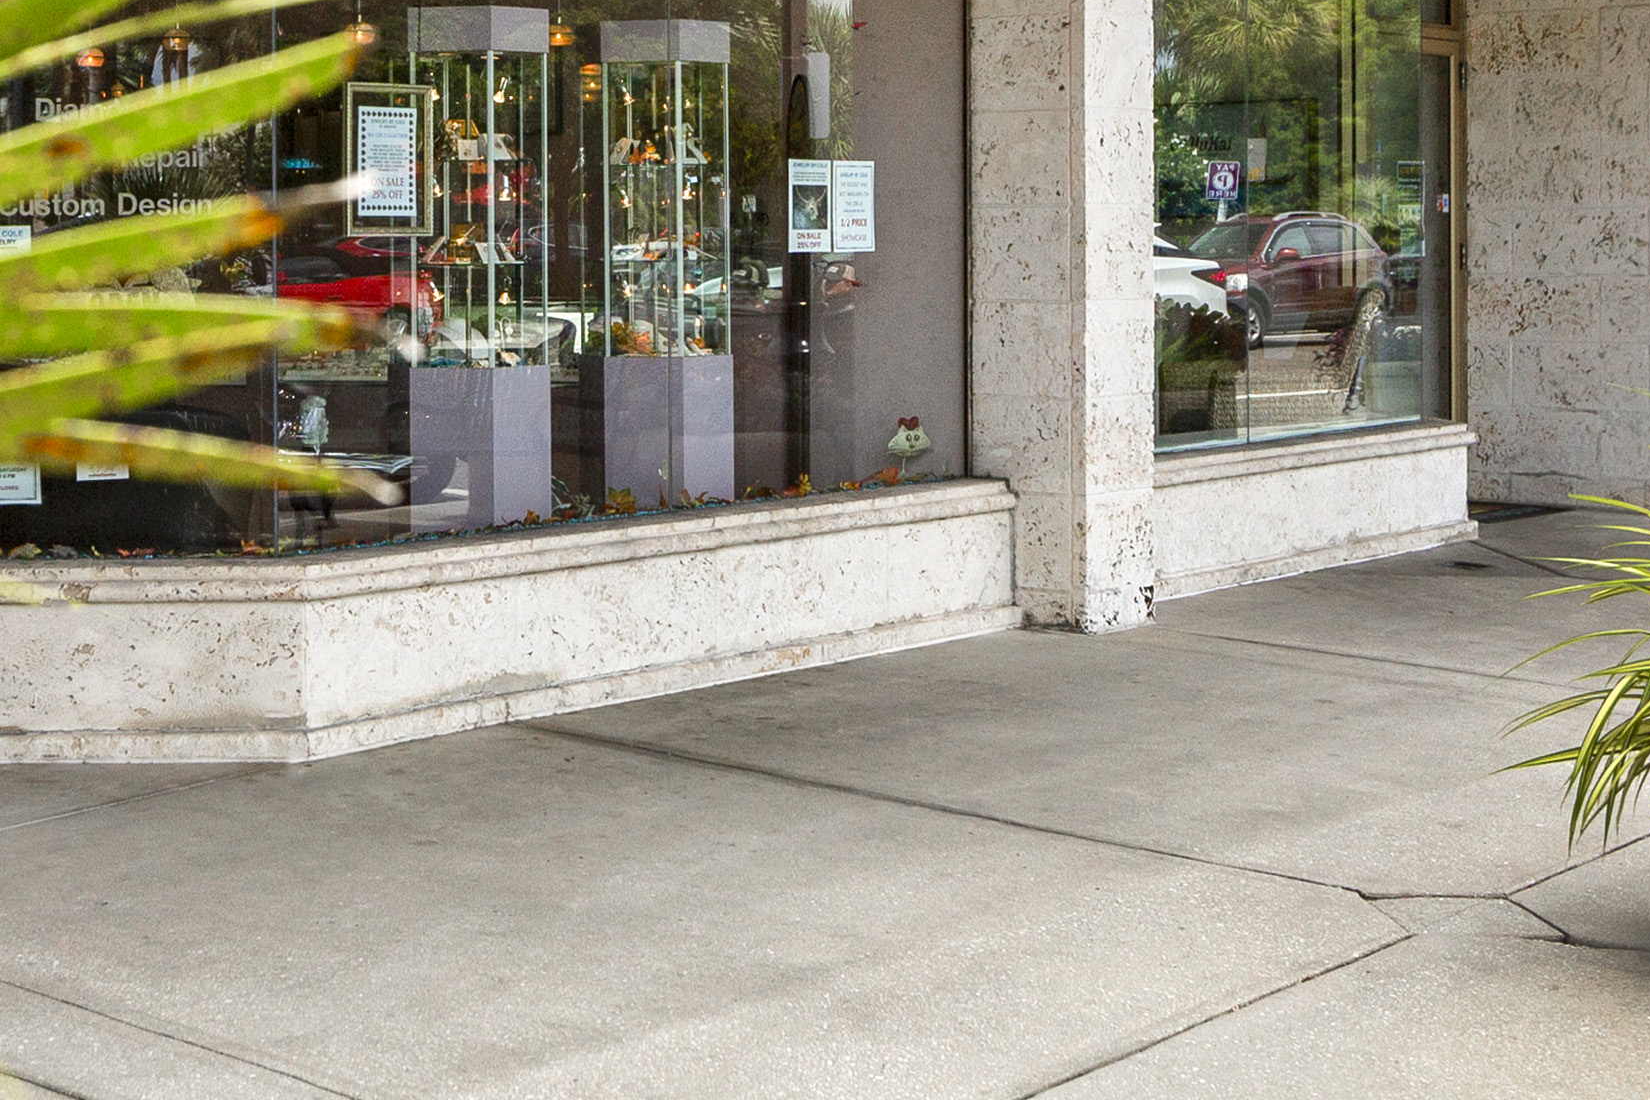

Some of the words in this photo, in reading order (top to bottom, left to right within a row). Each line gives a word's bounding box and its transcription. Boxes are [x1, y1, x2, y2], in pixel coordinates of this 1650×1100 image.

[122, 144, 204, 173] epair
[386, 177, 405, 187] SALE
[388, 189, 404, 200] OFF
[0, 193, 105, 217] Custom
[118, 193, 213, 222] Design
[851, 218, 868, 227] PRICE
[1, 229, 24, 238] COLE
[806, 232, 822, 240] SALE
[810, 241, 822, 249] OFF
